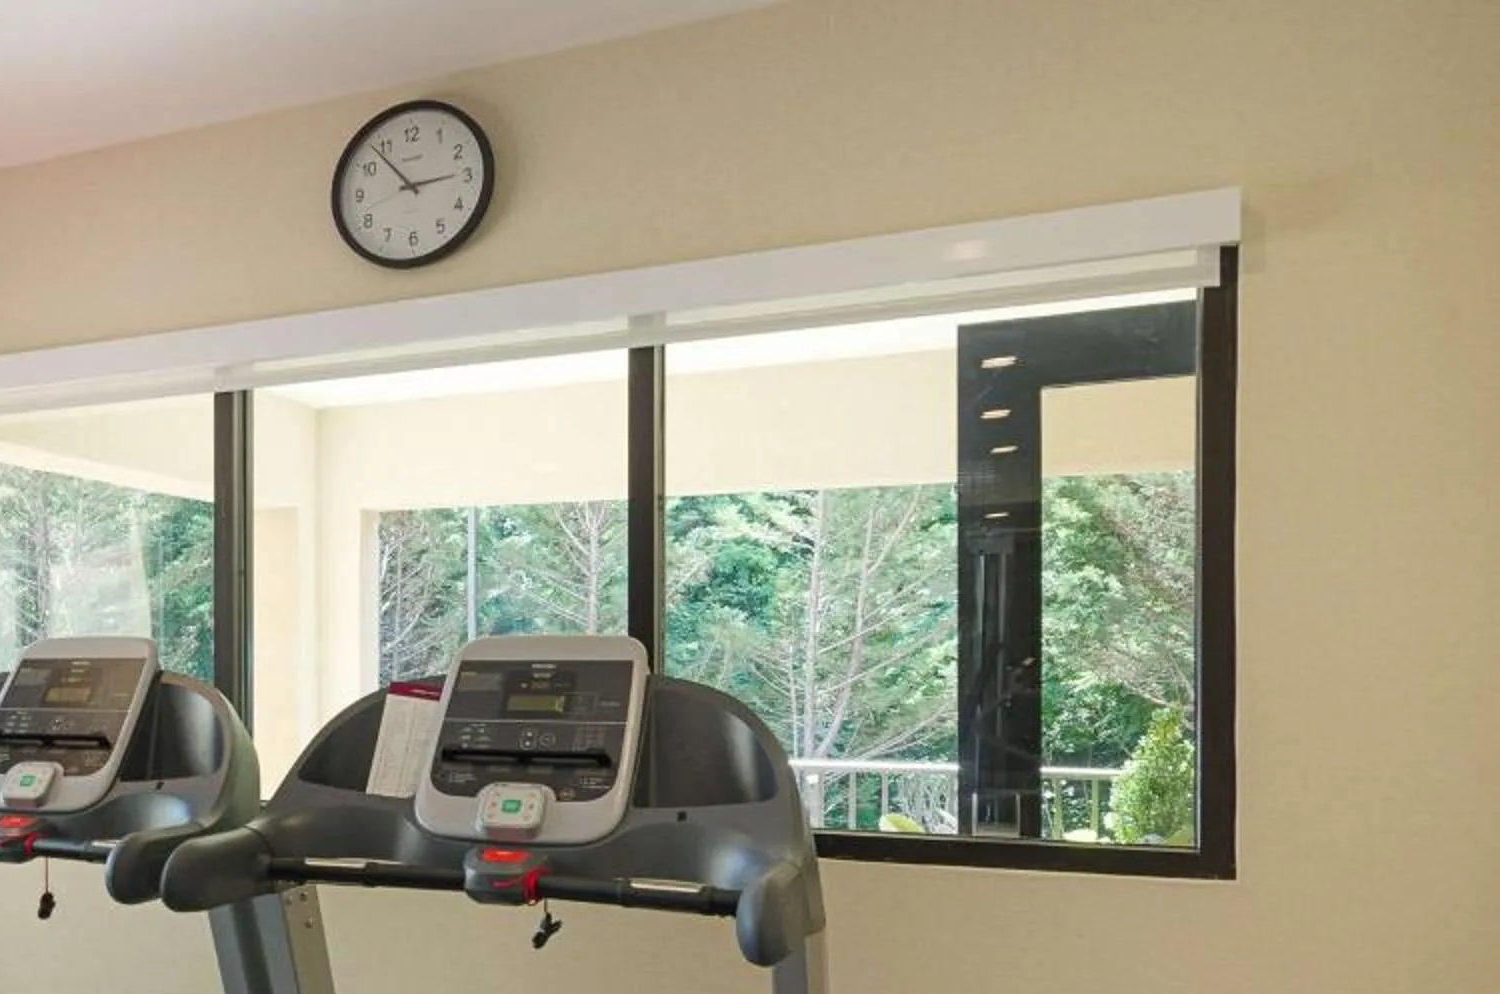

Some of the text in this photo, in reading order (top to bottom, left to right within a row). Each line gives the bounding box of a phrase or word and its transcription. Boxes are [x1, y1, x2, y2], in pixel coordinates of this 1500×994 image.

[404, 126, 420, 143] 12
[436, 128, 443, 144] 1
[380, 140, 393, 153] 11
[453, 143, 463, 161] 2
[362, 161, 377, 177] 10
[463, 167, 473, 183] 3
[355, 188, 364, 203] 9
[454, 197, 464, 211] 4
[363, 213, 373, 229] 8
[436, 218, 446, 234] 5
[382, 227, 392, 242] 7
[409, 231, 419, 247] 6
